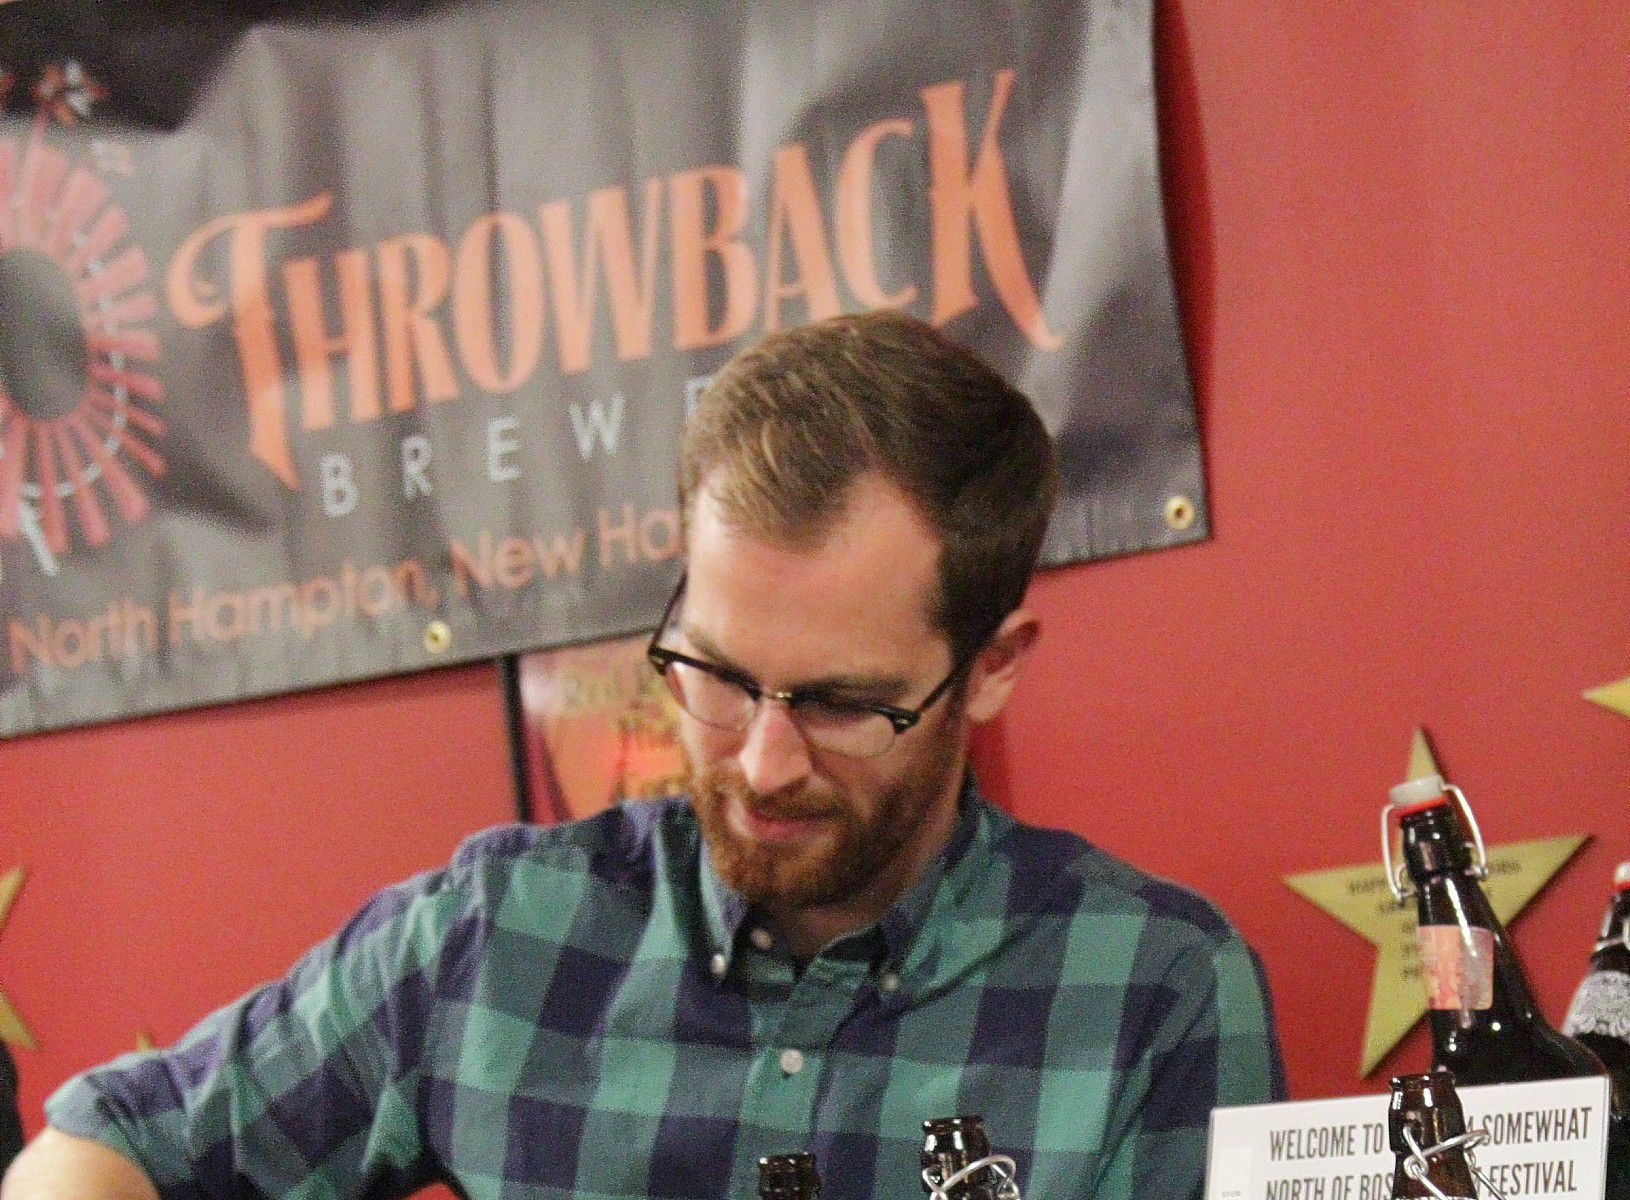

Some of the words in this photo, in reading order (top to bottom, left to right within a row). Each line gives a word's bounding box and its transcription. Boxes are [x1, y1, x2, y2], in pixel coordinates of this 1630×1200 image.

[165, 70, 1062, 490] THROWBACK
[8, 600, 159, 674] North
[451, 528, 588, 598] New
[1269, 1125, 1357, 1161] WELCOME
[1363, 1123, 1384, 1155] TO
[1482, 1107, 1592, 1146] SOMEWHAT
[1488, 1160, 1577, 1197] FESTIVAL
